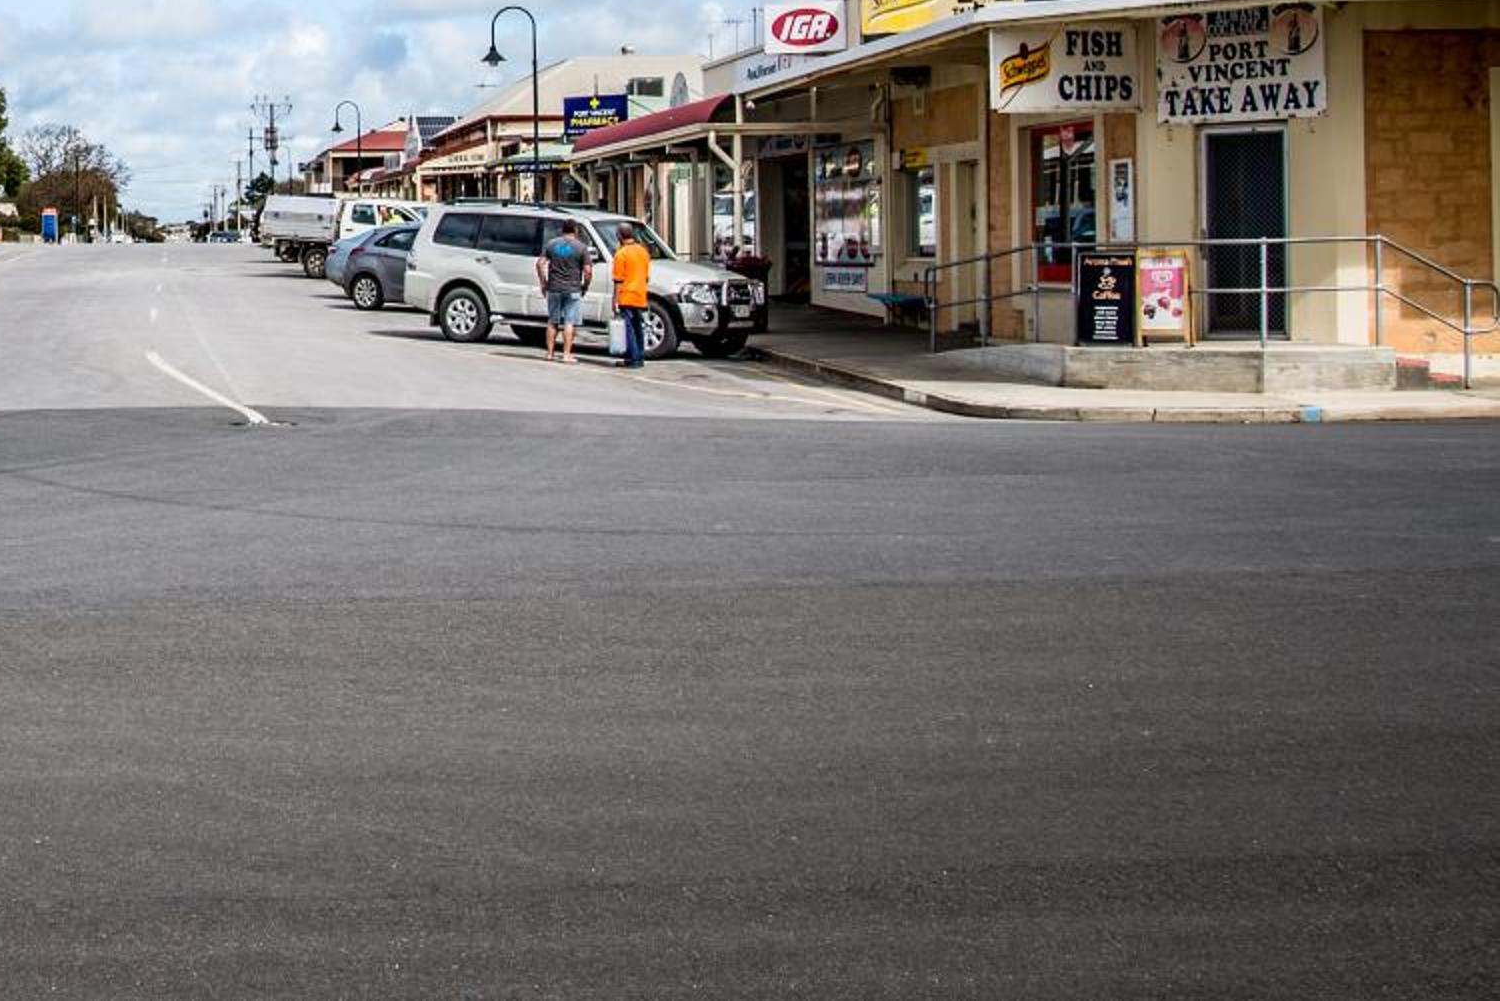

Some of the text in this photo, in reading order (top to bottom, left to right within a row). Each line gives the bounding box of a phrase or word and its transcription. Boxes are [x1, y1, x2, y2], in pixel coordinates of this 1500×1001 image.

[1066, 30, 1123, 57] FISH
[1209, 40, 1269, 62] PORT
[1083, 60, 1106, 72] AND
[1188, 59, 1290, 83] VINCENT
[1059, 75, 1132, 100] CHIPS
[1165, 81, 1319, 116] TAKE AWAY
